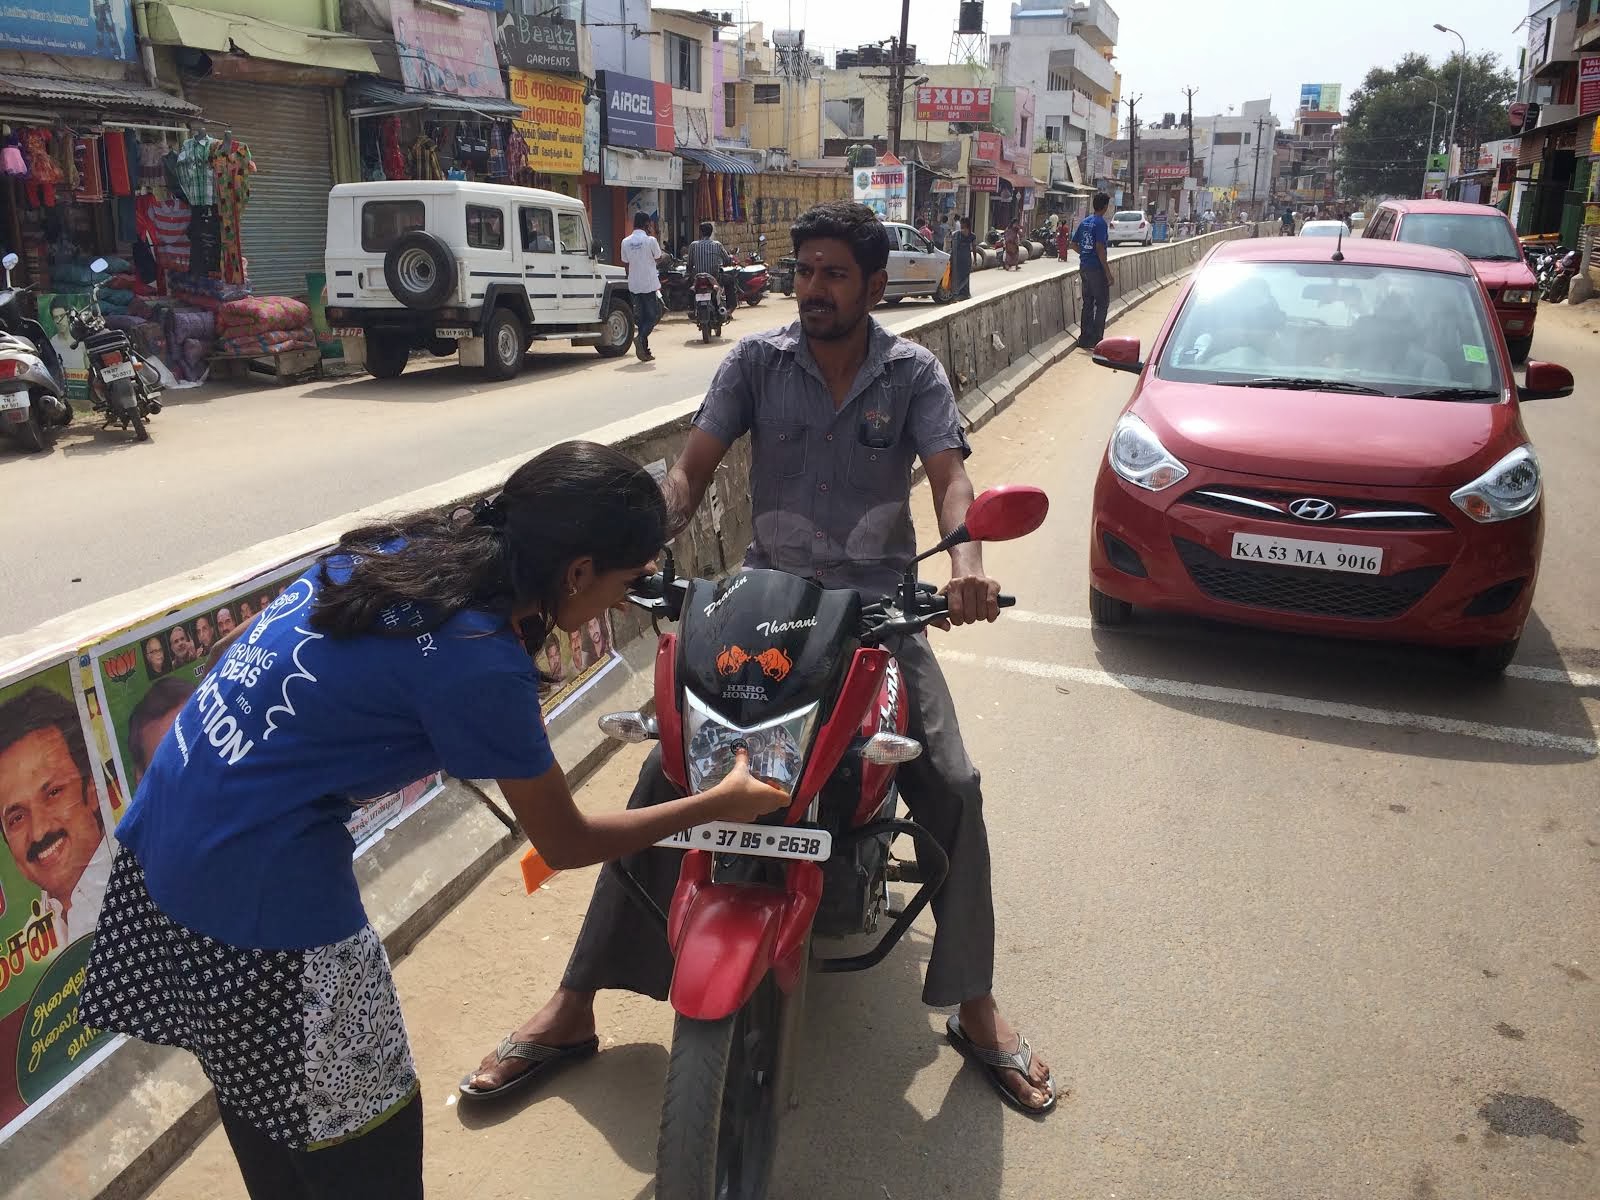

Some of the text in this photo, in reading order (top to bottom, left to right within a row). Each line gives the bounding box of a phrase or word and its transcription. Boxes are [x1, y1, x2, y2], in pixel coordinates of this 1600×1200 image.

[526, 53, 570, 66] GARMENTS
[531, 80, 580, 104] சரவணா
[918, 88, 989, 105] EXIDE
[971, 177, 997, 185] EXIDE
[336, 328, 363, 336] STOP
[1235, 542, 1377, 570] KA 53 MA 9016
[756, 615, 818, 637] Tharani
[722, 691, 769, 701] HONDA
[727, 684, 765, 693] HERO
[235, 692, 252, 715] into
[196, 672, 255, 766] ACTION
[716, 829, 738, 847] 37
[740, 831, 762, 849] BS
[777, 835, 821, 855] 2638
[31, 964, 88, 1038] அனைவ
